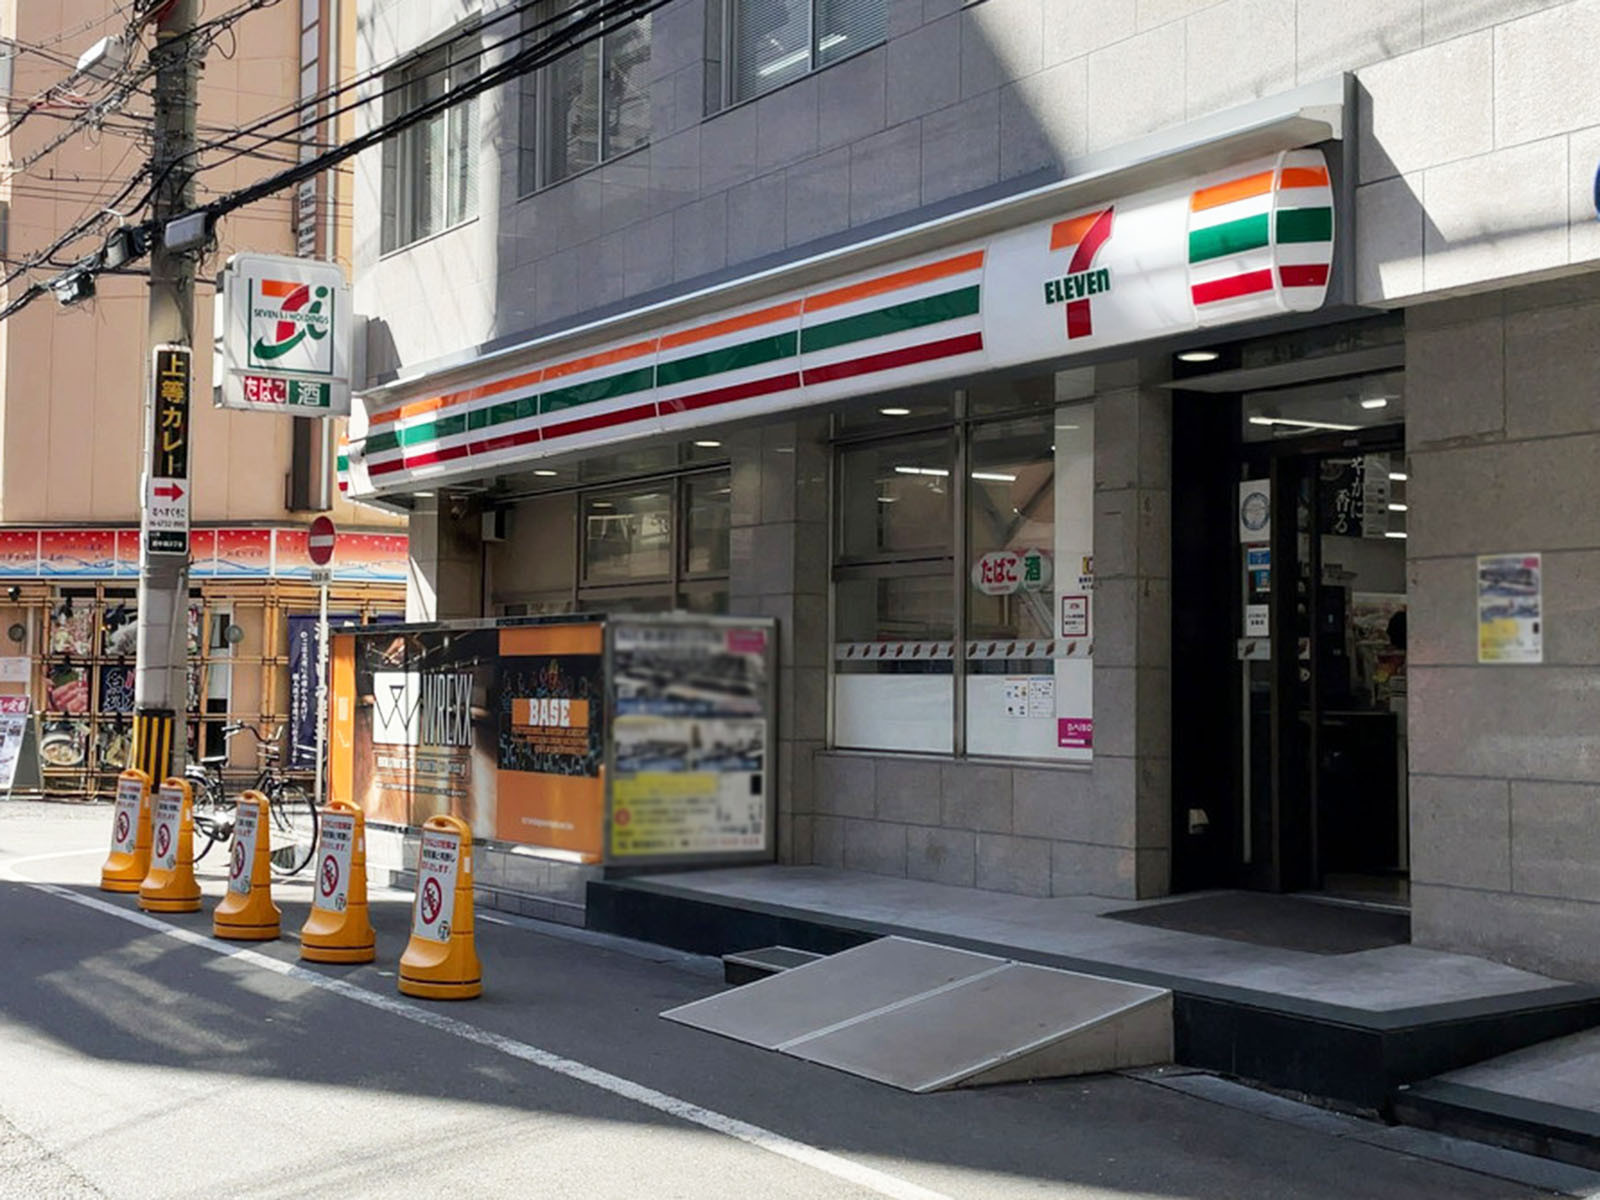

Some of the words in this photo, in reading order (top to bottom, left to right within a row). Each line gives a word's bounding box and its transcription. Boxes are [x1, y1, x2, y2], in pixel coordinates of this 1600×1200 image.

[245, 376, 286, 403] たばこ
[298, 381, 321, 405] 酒
[160, 352, 186, 476] 上等カレー
[981, 557, 1017, 584] たばこ
[1024, 555, 1042, 582] 酒
[422, 673, 474, 747] WREXX
[528, 697, 571, 727] BASE
